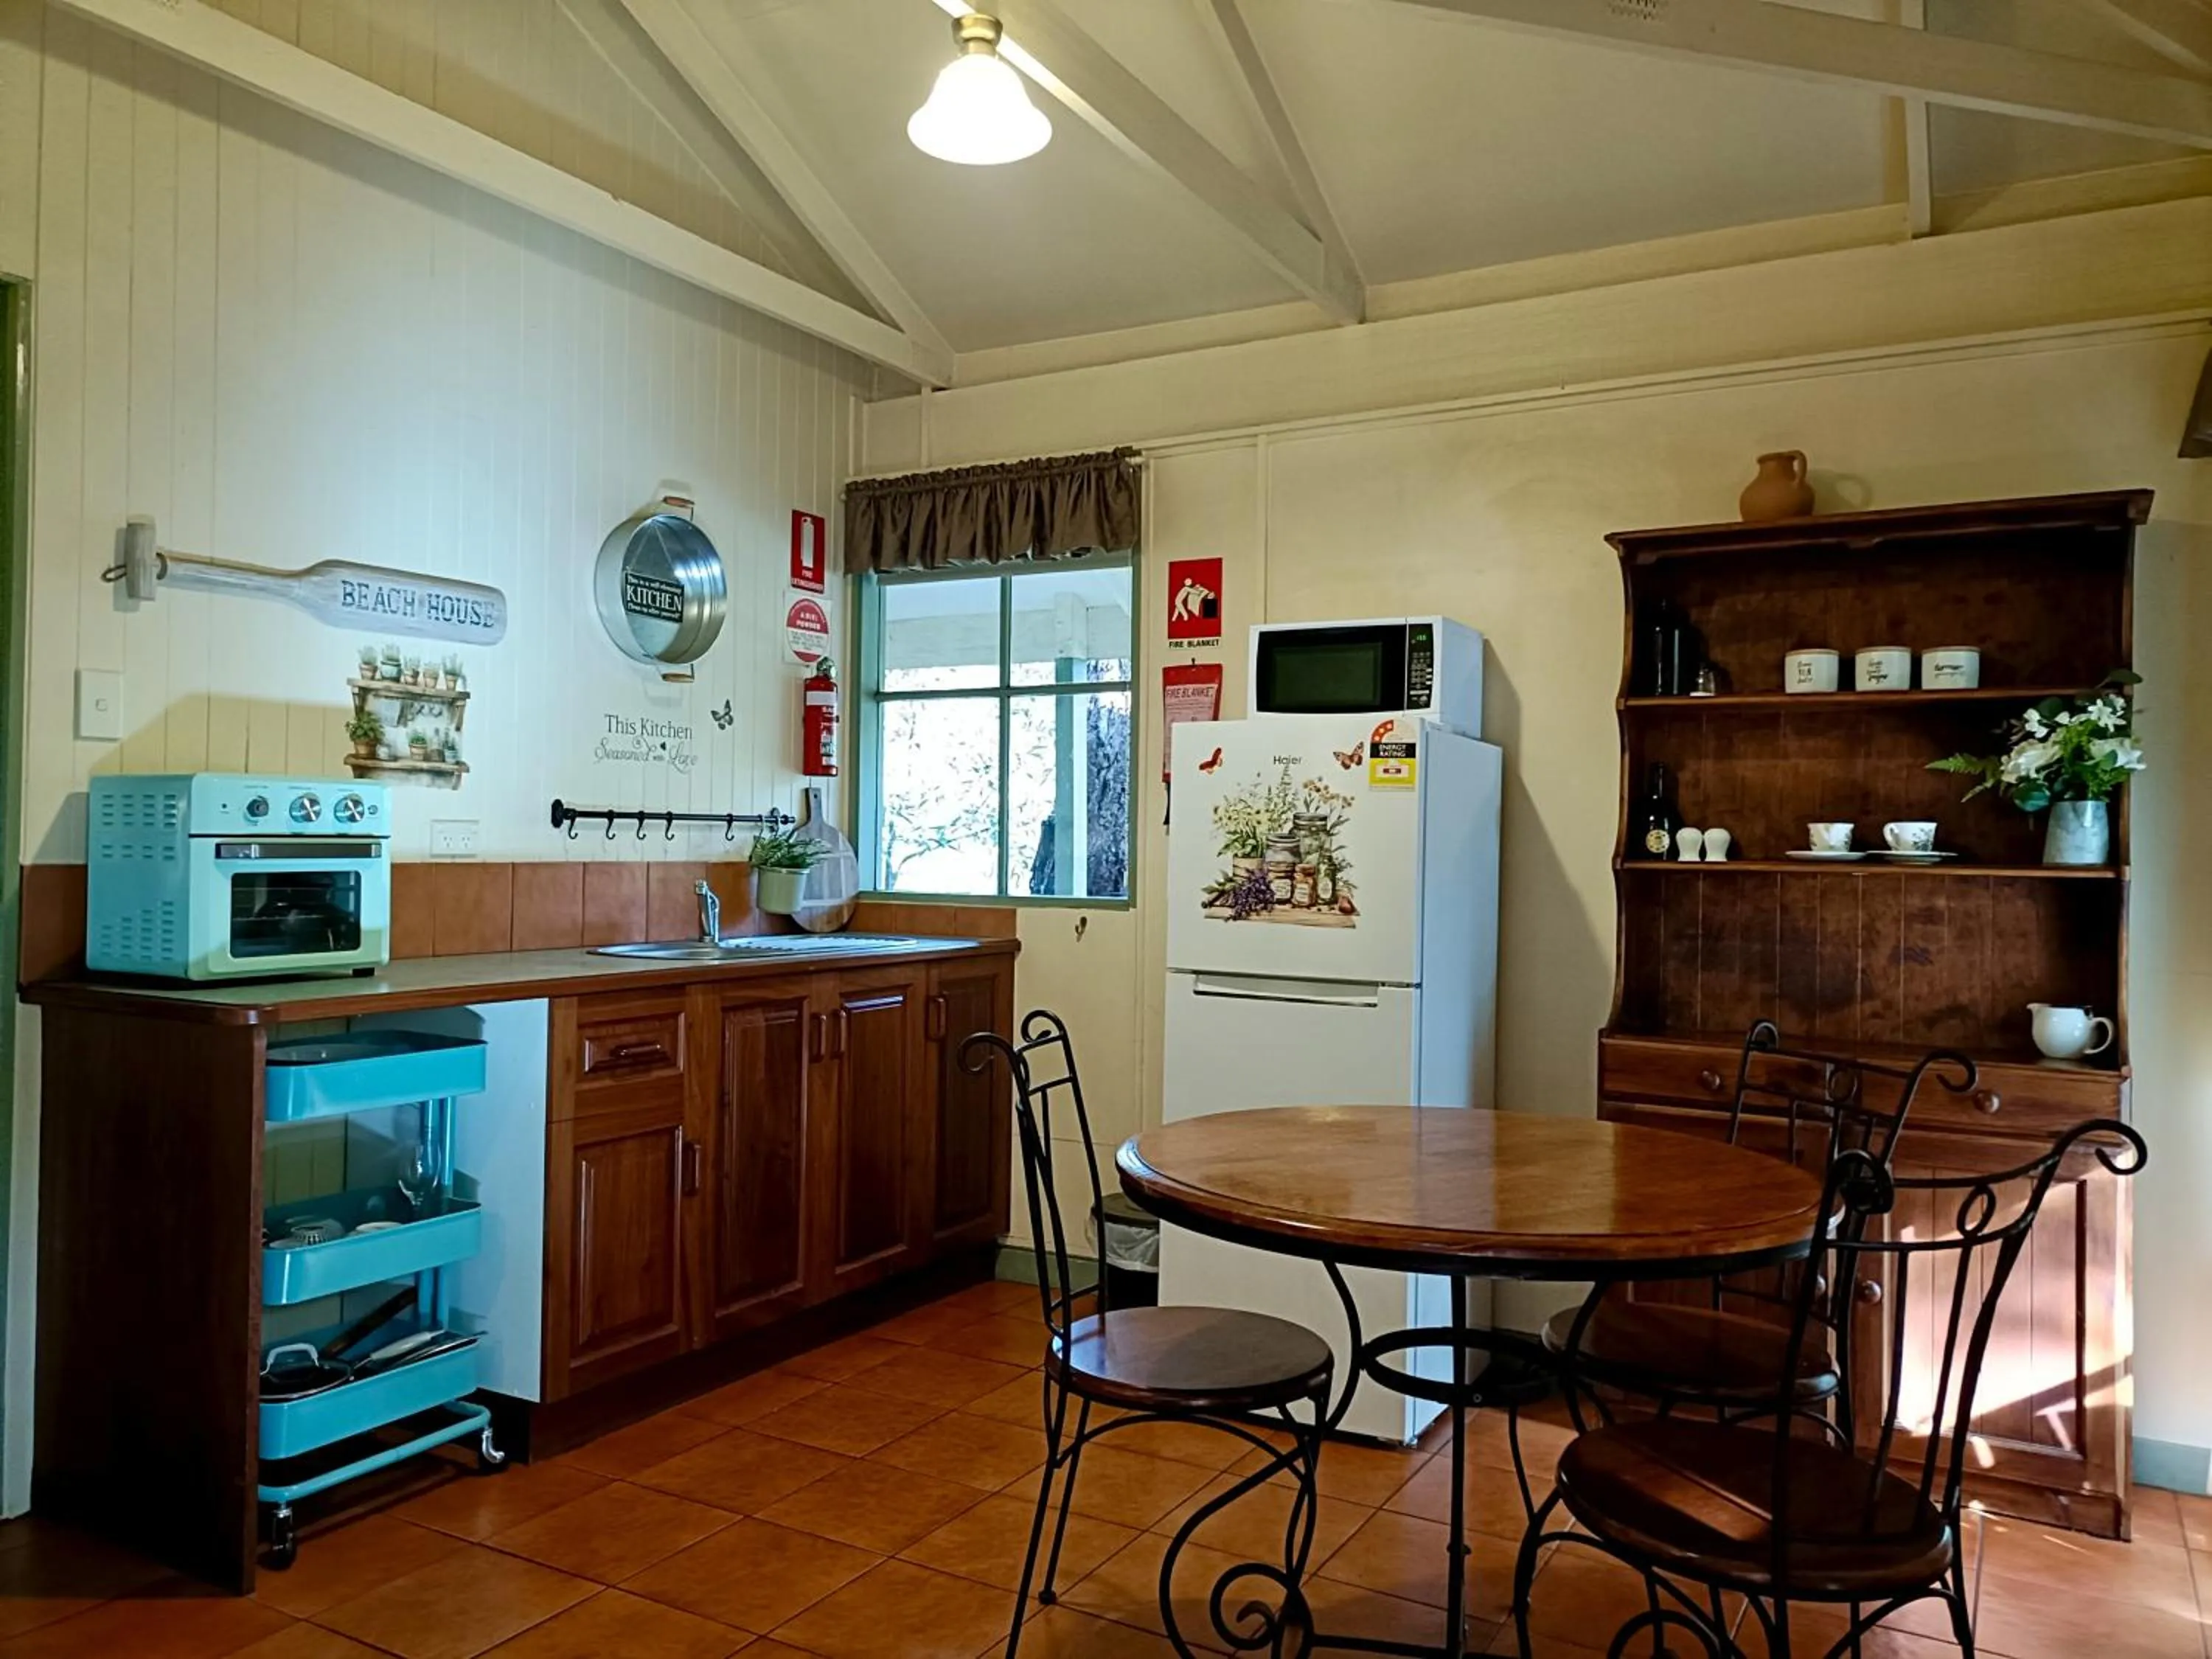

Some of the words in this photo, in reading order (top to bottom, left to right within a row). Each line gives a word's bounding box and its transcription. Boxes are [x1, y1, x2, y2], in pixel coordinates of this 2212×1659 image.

[341, 580, 416, 618] BEACH
[426, 593, 495, 627] HOUSE
[627, 584, 682, 612] KITCHEN
[796, 619, 821, 630] POWDER
[1187, 639, 1220, 647] BLANKET
[1166, 688, 1181, 698] FIRE
[605, 714, 636, 736] This
[640, 717, 692, 740] Kitchen
[1379, 743, 1406, 751] ENERGY
[1273, 754, 1303, 765] Haier
